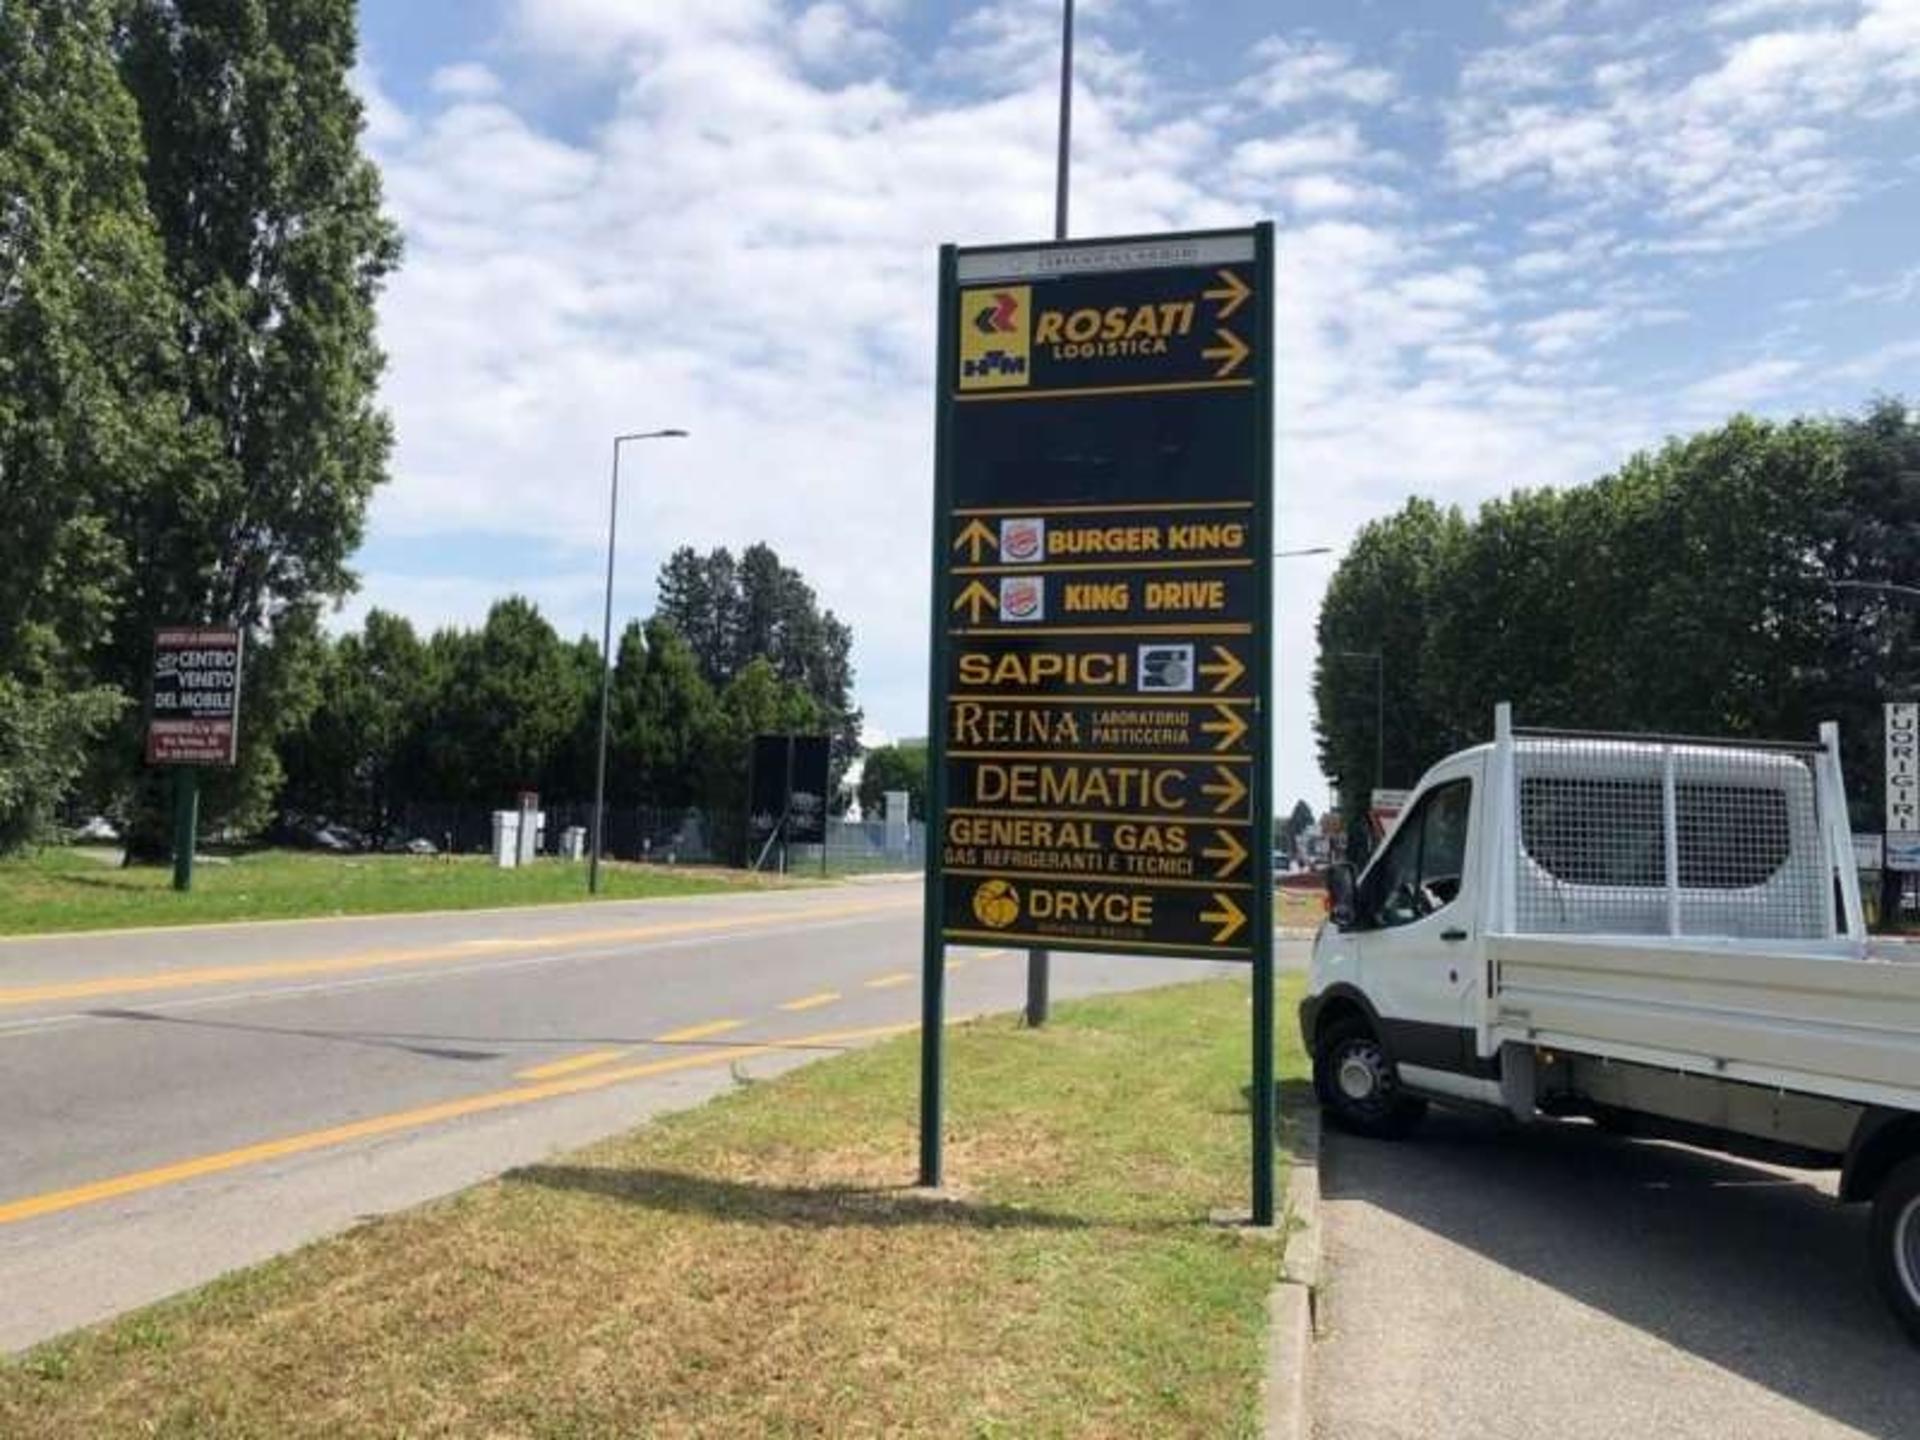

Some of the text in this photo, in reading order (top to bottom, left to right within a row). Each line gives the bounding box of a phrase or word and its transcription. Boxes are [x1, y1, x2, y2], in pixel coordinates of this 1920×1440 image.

[1035, 302, 1195, 344] ROSATI
[1054, 340, 1168, 359] LOGISTICA
[1047, 524, 1244, 554] BURGER KING
[1064, 581, 1225, 611] KING DRIVE
[179, 651, 236, 668] CENTRO
[958, 653, 1128, 685] SAPICI
[178, 672, 234, 688] VENETO
[155, 692, 232, 709] DEL MOBILE
[954, 702, 1080, 744] REINA
[1091, 710, 1190, 726] LABORATORIO
[1091, 729, 1190, 744] PASTICCERIA
[976, 764, 1187, 809] DEMATIC
[949, 818, 1188, 852] GENERAL GAS
[983, 848, 1103, 871] REFRIGERANTI
[1127, 855, 1193, 876] TECNICI
[1029, 889, 1153, 924] DRYCE
